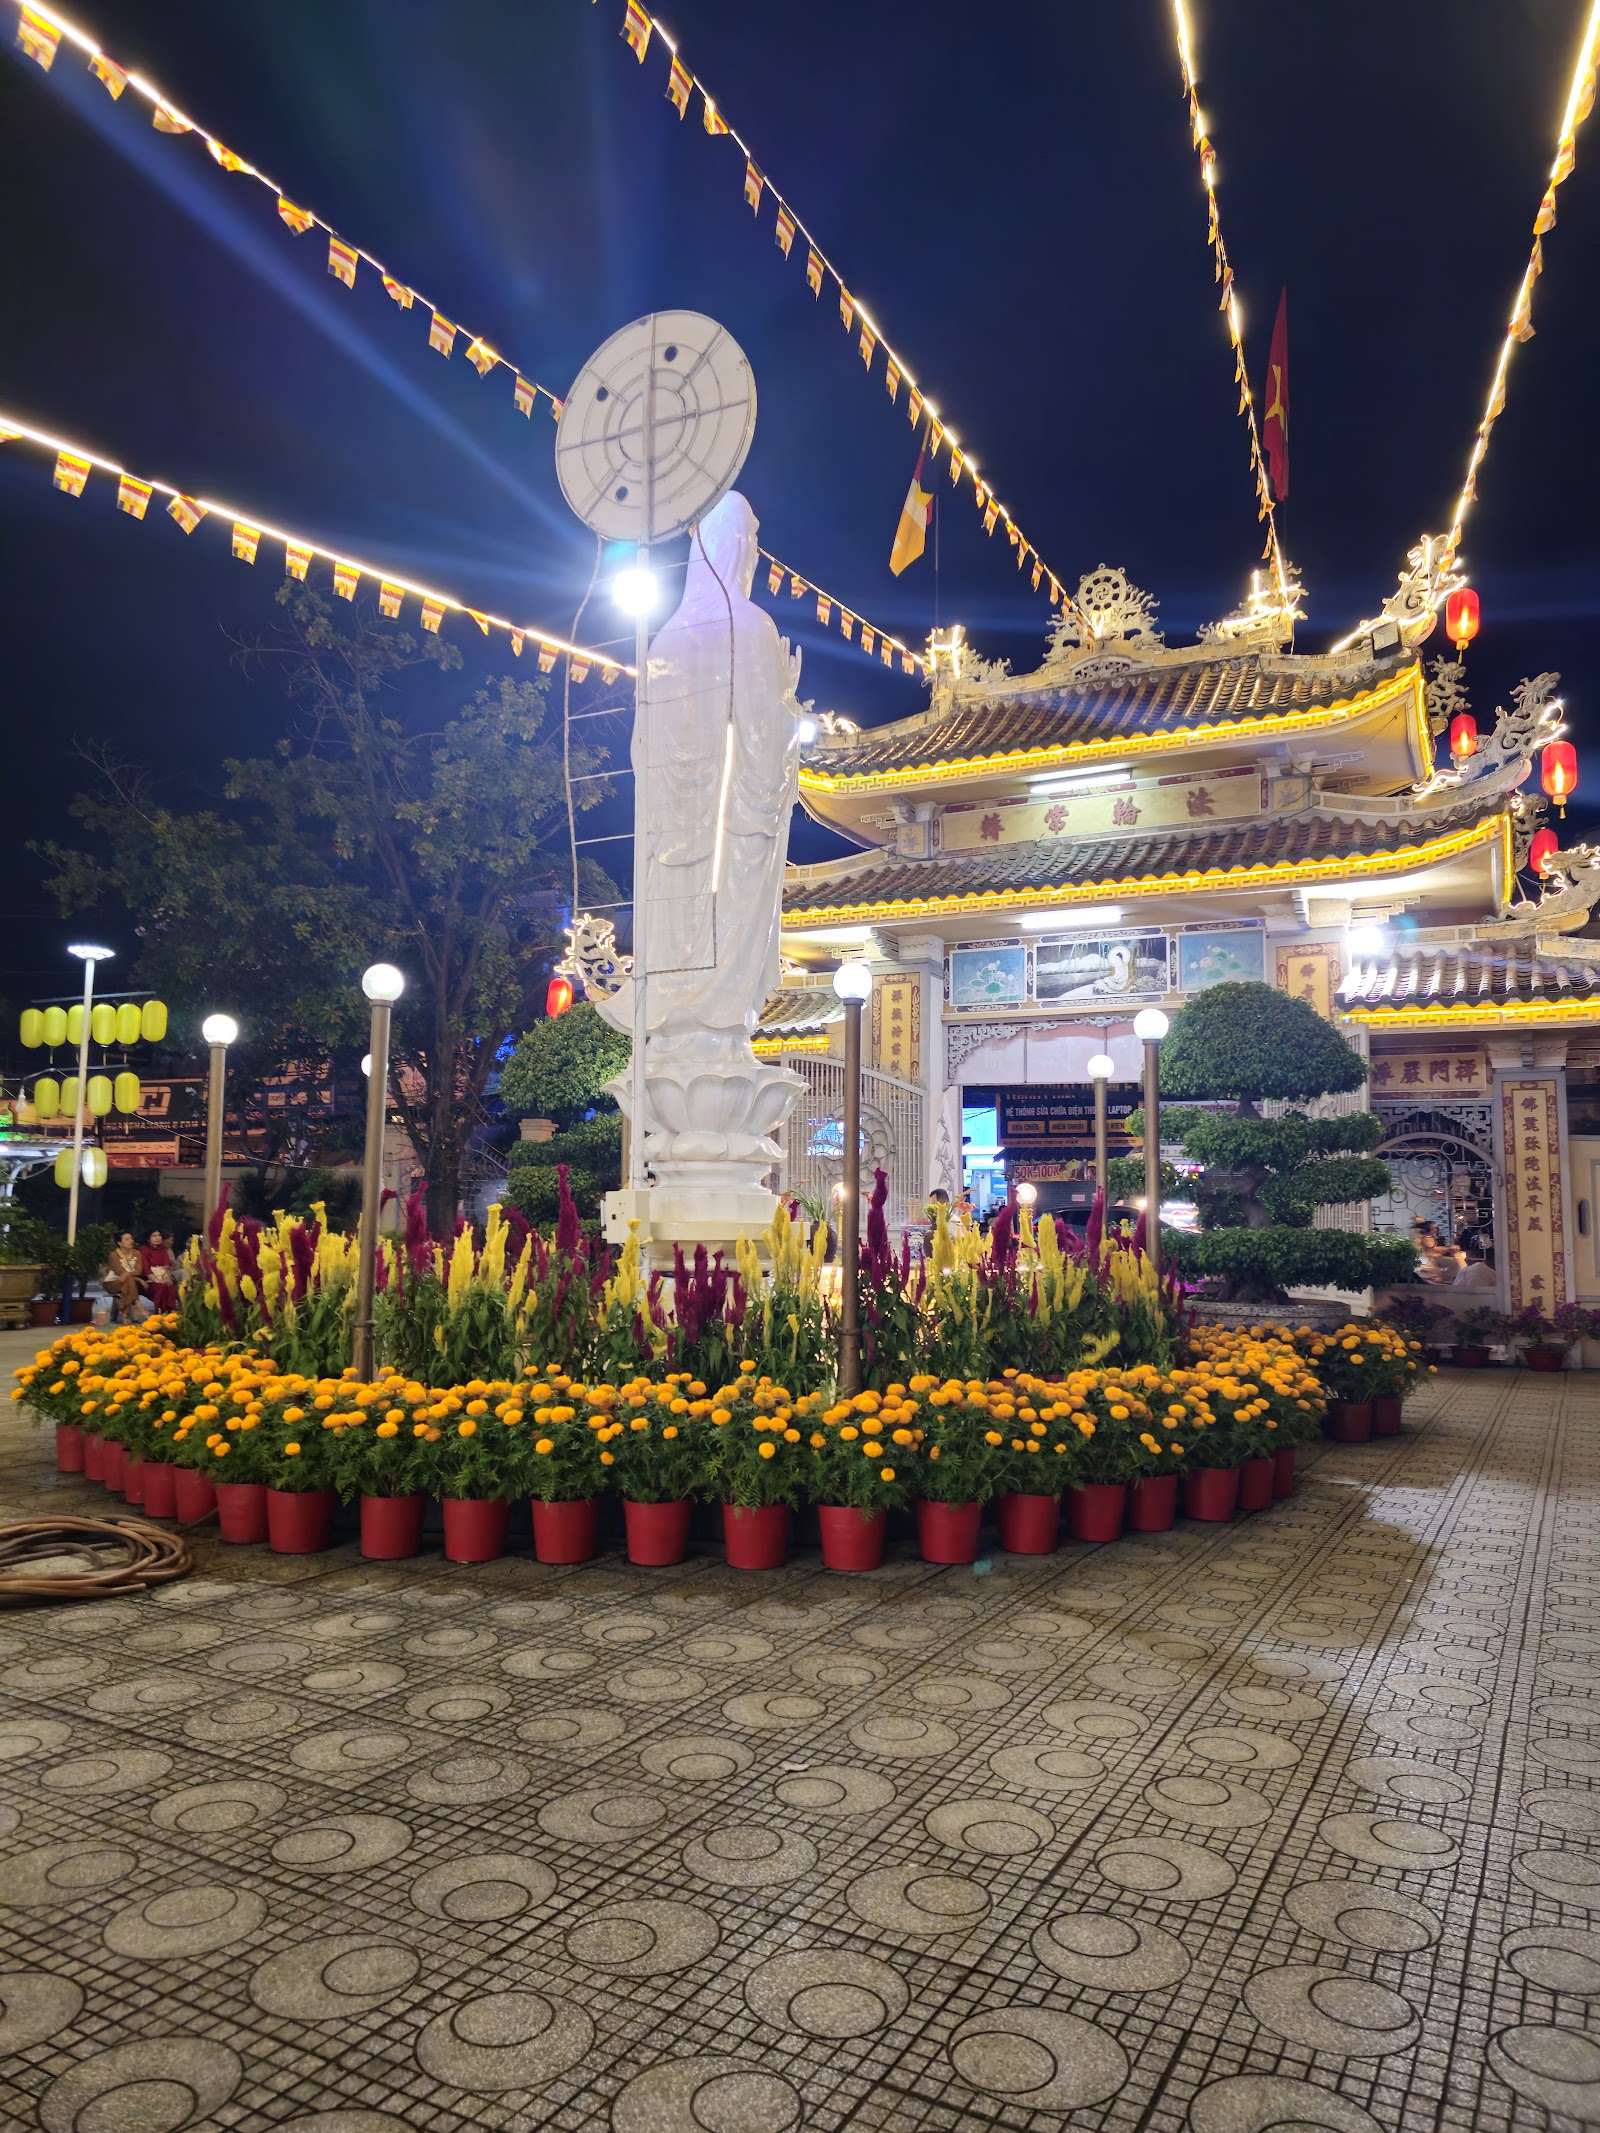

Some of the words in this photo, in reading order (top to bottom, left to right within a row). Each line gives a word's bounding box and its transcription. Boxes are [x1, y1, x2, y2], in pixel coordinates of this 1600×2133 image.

[1015, 1105, 1035, 1116] THỐNG
[1036, 1105, 1049, 1116] SỬA
[1050, 1105, 1067, 1115] CHỮA
[1108, 1105, 1132, 1114] LAPTOP
